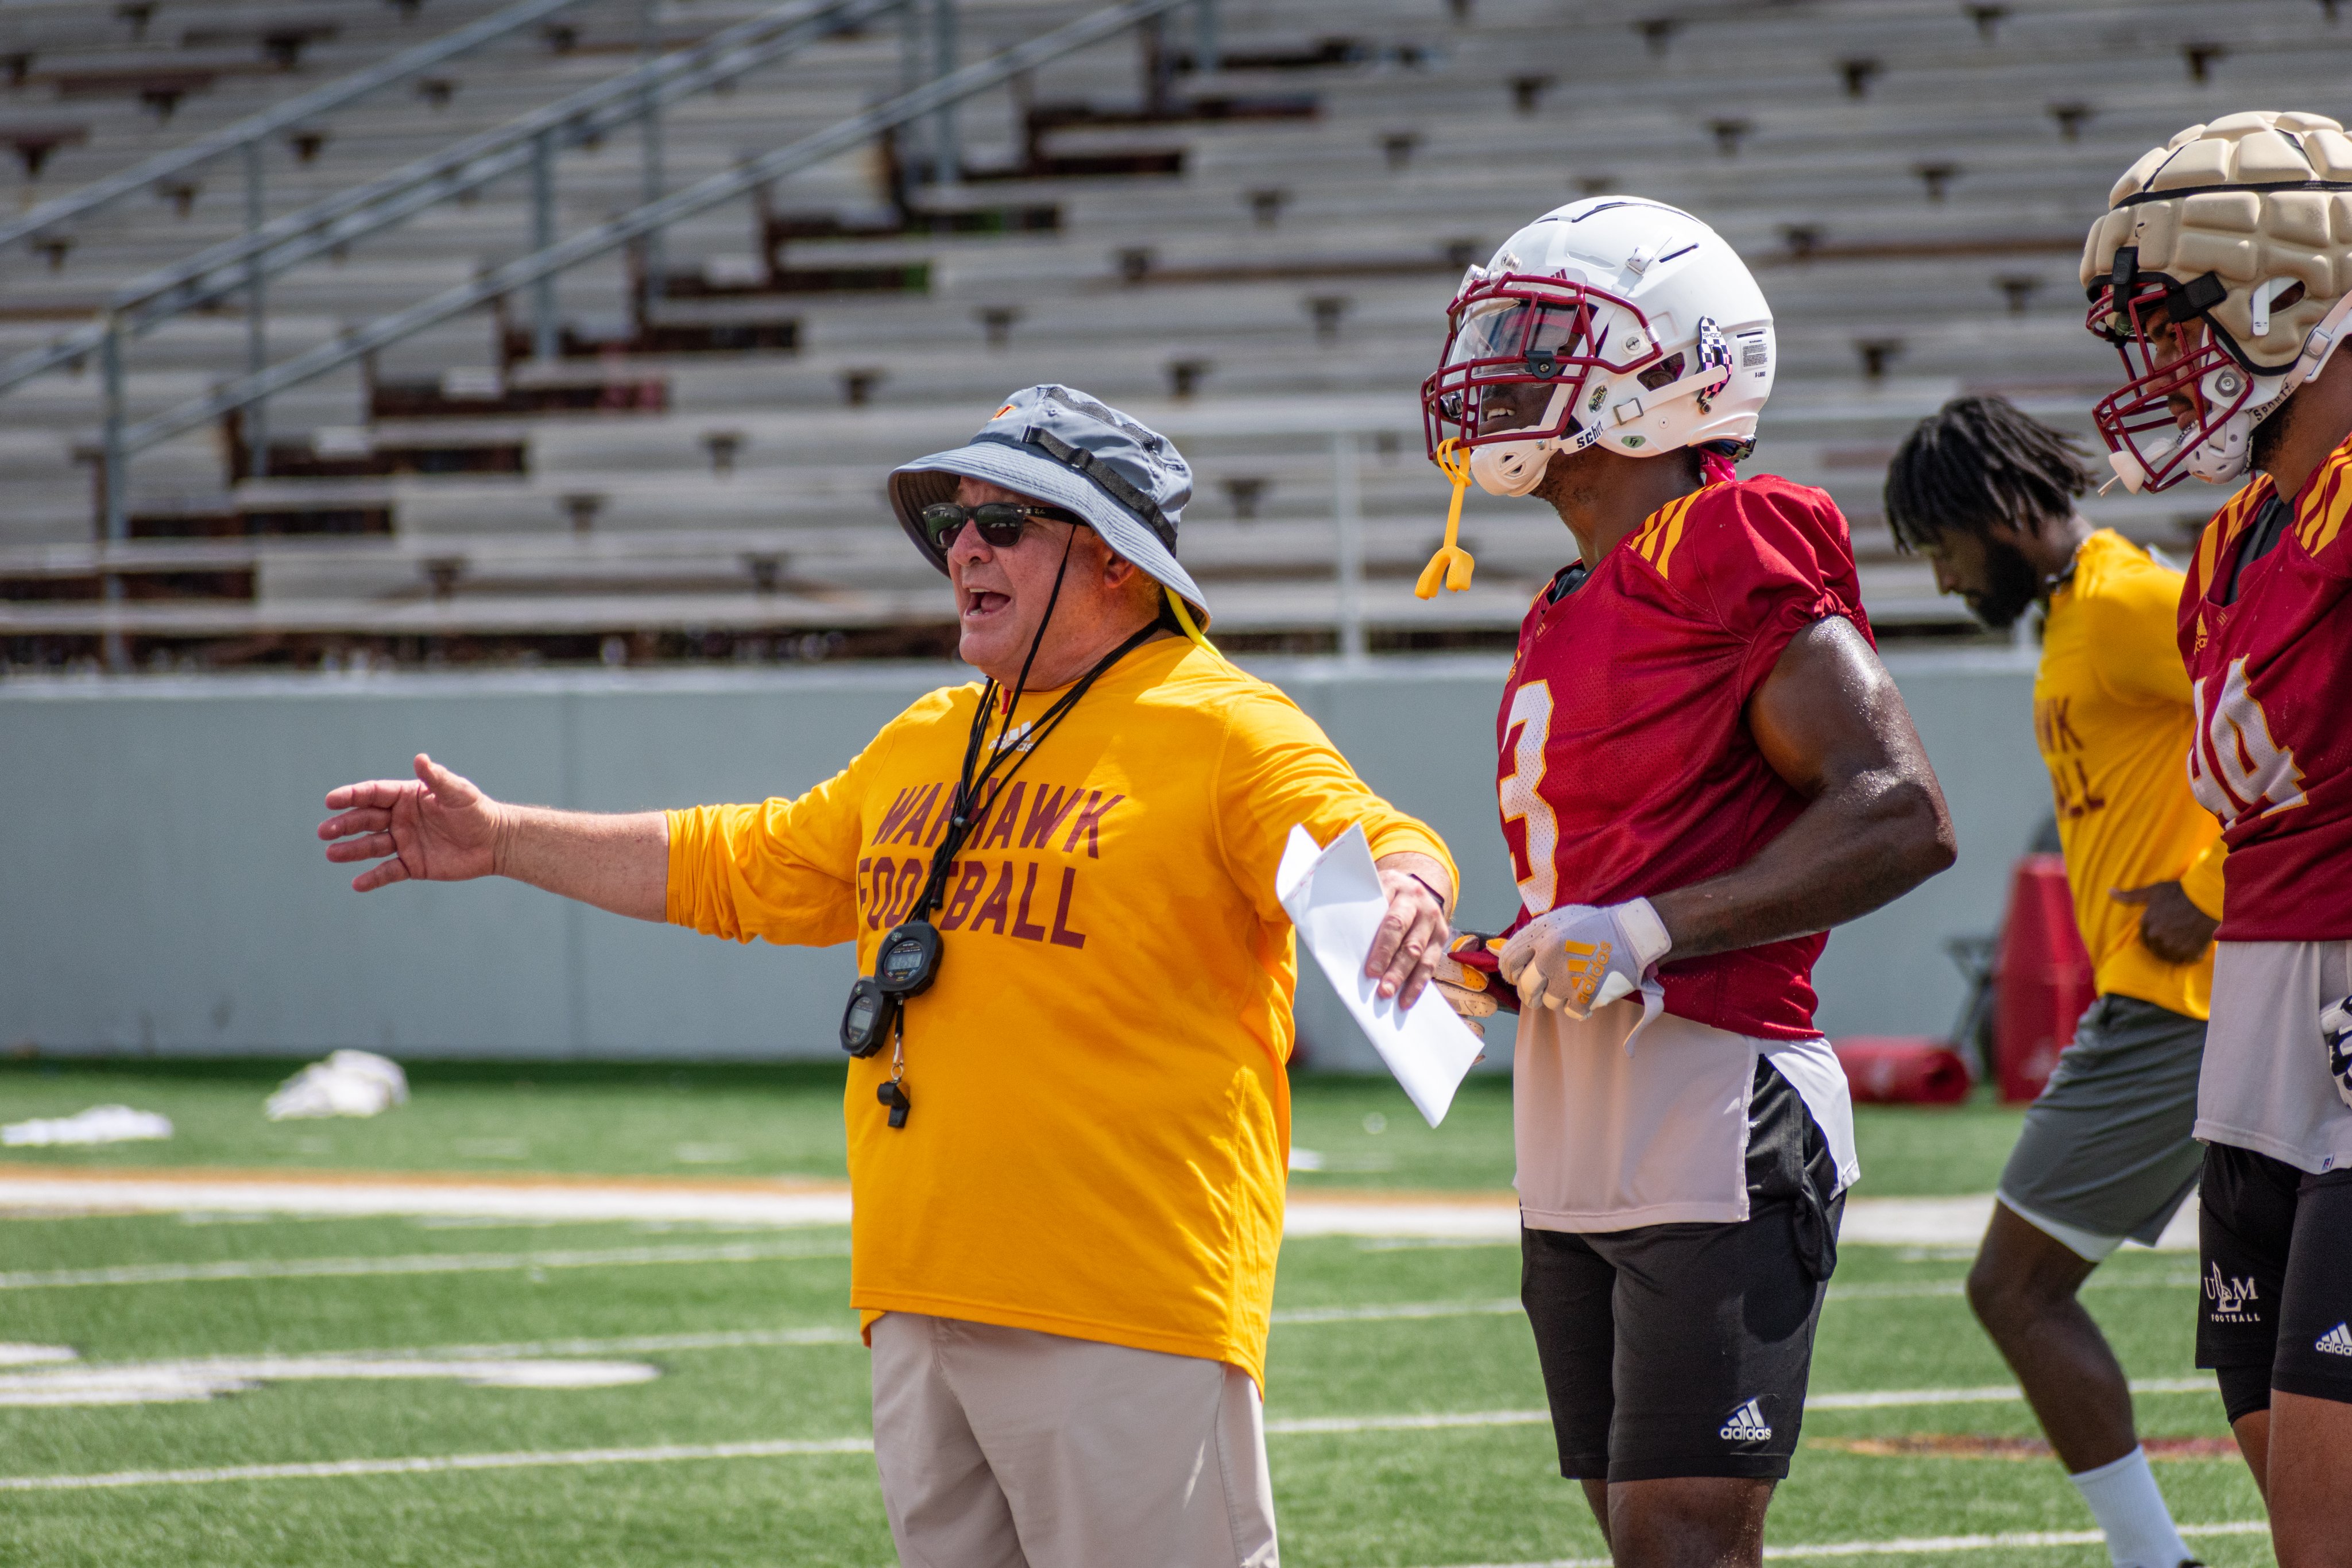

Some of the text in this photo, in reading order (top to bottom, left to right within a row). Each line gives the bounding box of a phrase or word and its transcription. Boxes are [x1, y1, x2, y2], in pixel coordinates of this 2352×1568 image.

[988, 737, 1035, 752] aias
[1500, 679, 1558, 917] 3
[1577, 940, 1613, 1005] adidas
[2211, 1313, 2261, 1322] FOOTBALL
[2316, 1341, 2352, 1356] adida
[1720, 1425, 1771, 1441] adidas
